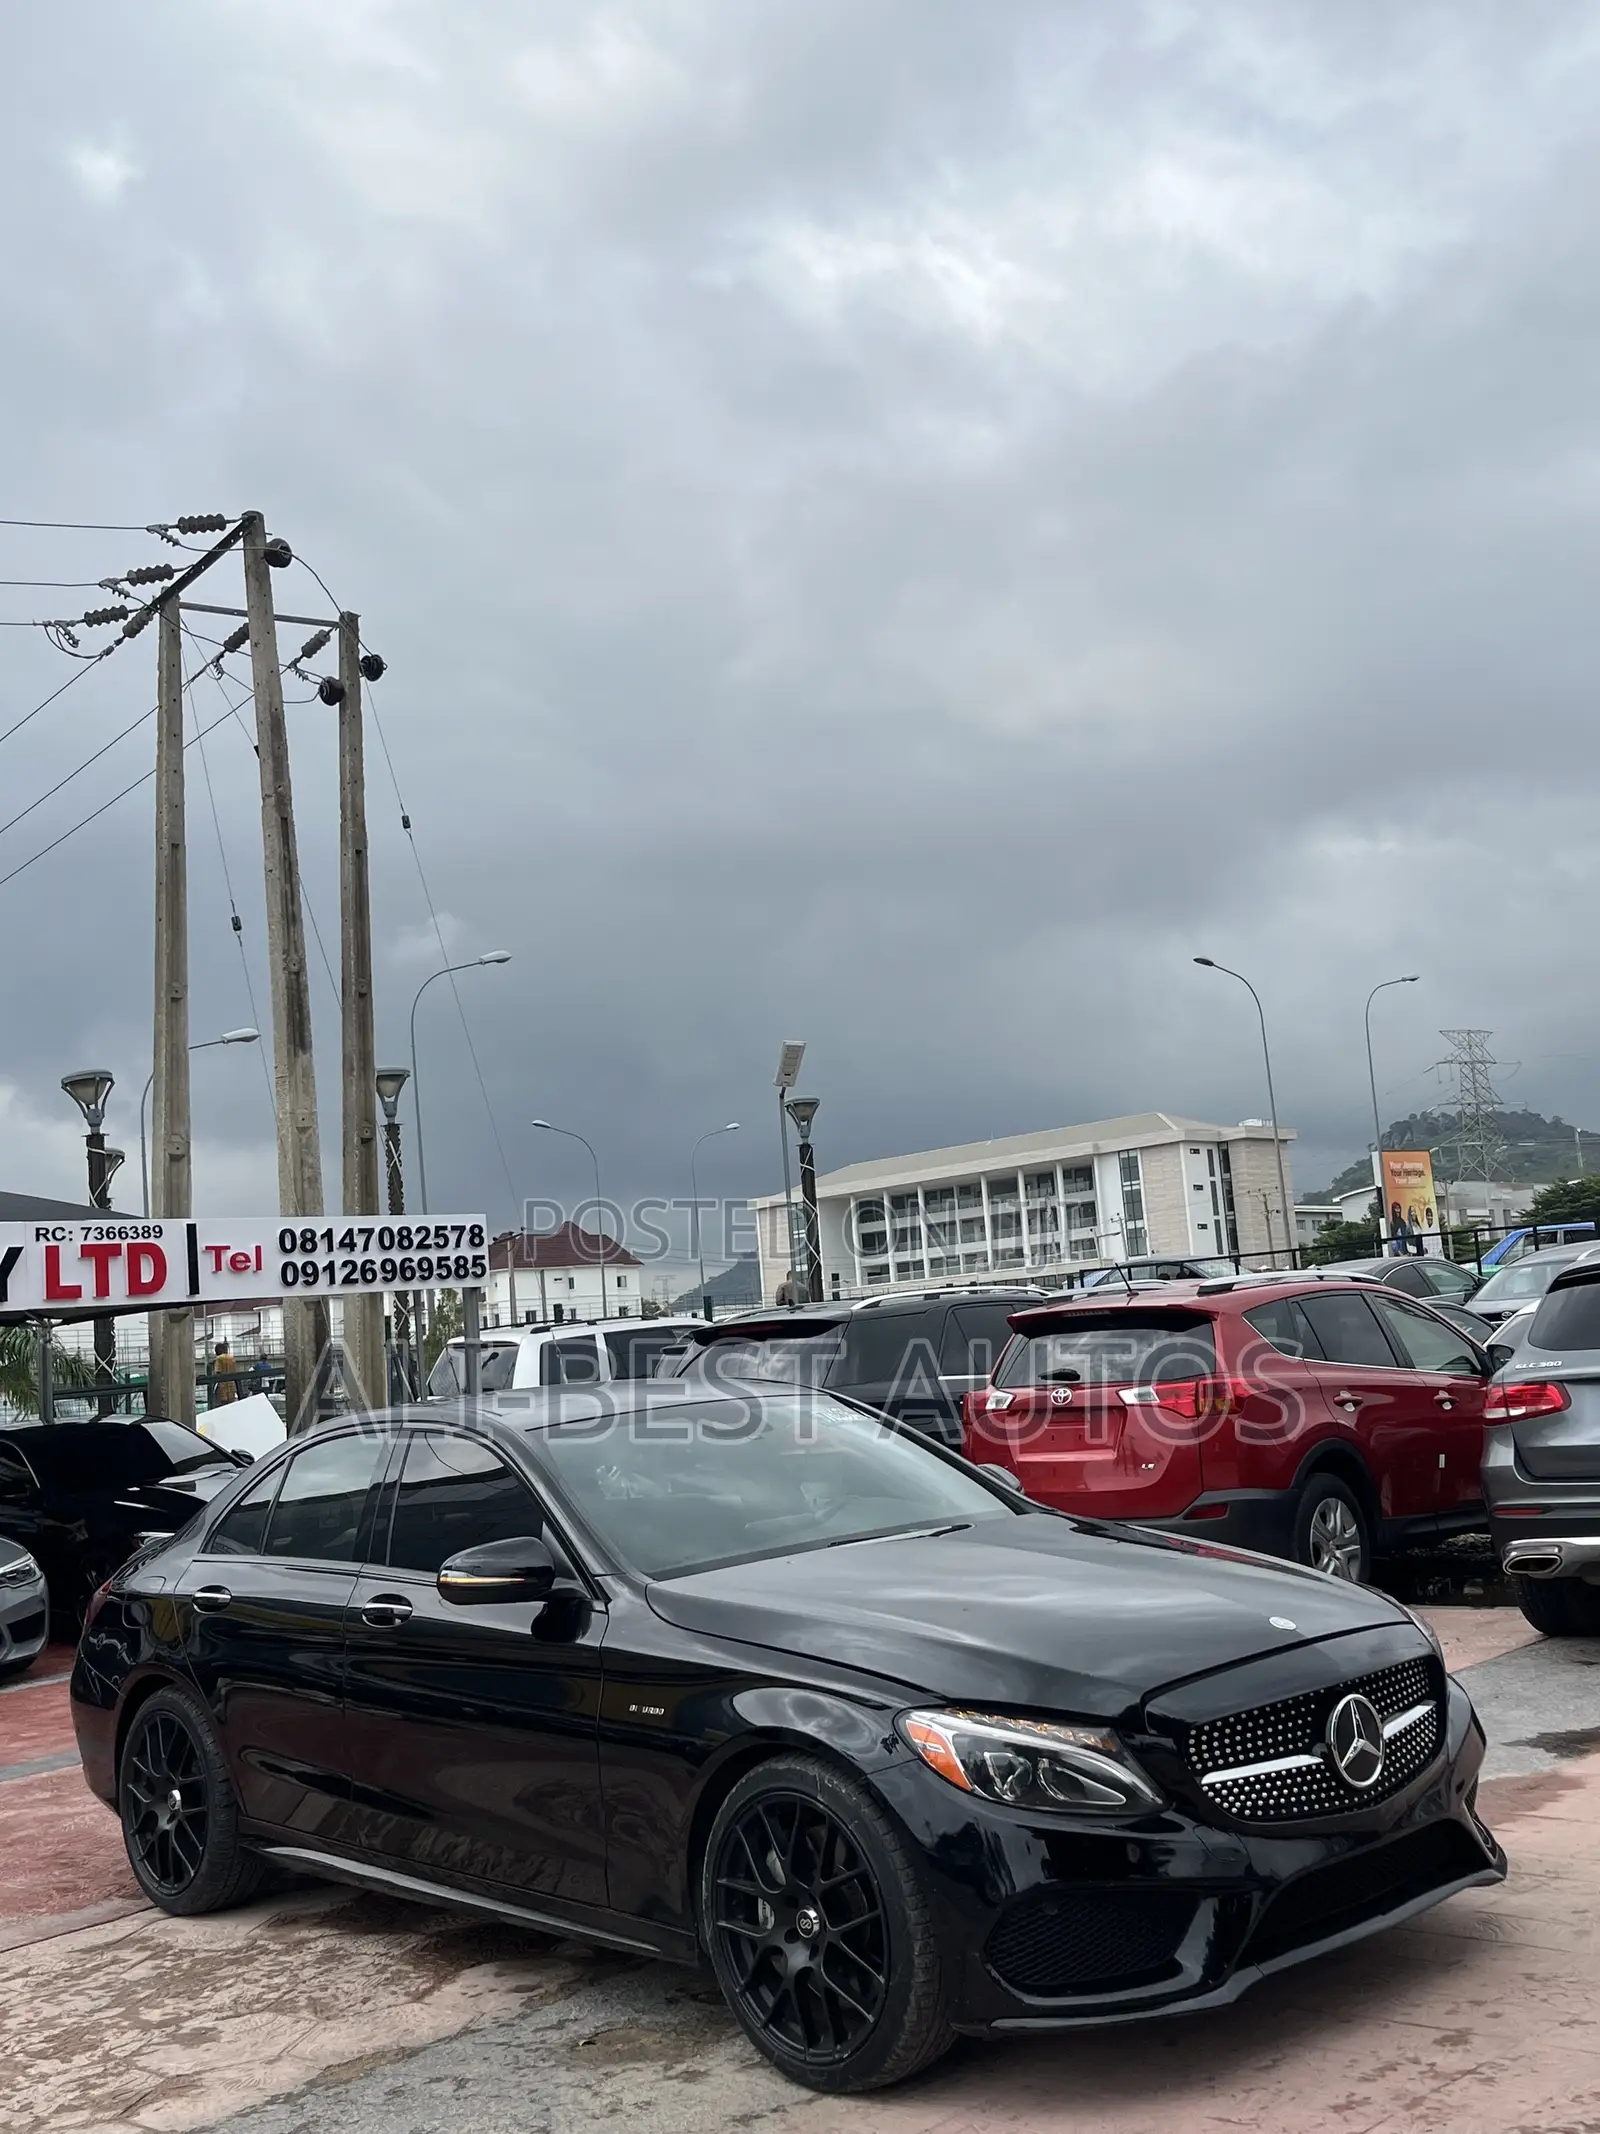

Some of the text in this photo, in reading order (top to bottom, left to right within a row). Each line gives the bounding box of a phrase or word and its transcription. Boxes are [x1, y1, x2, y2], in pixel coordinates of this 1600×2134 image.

[35, 1224, 164, 1242] RC: 7366389
[203, 1223, 485, 1273] Tel 08147082578
[44, 1242, 168, 1301] LTD
[280, 1254, 488, 1287] 09126969585
[1538, 1360, 1563, 1368] 300
